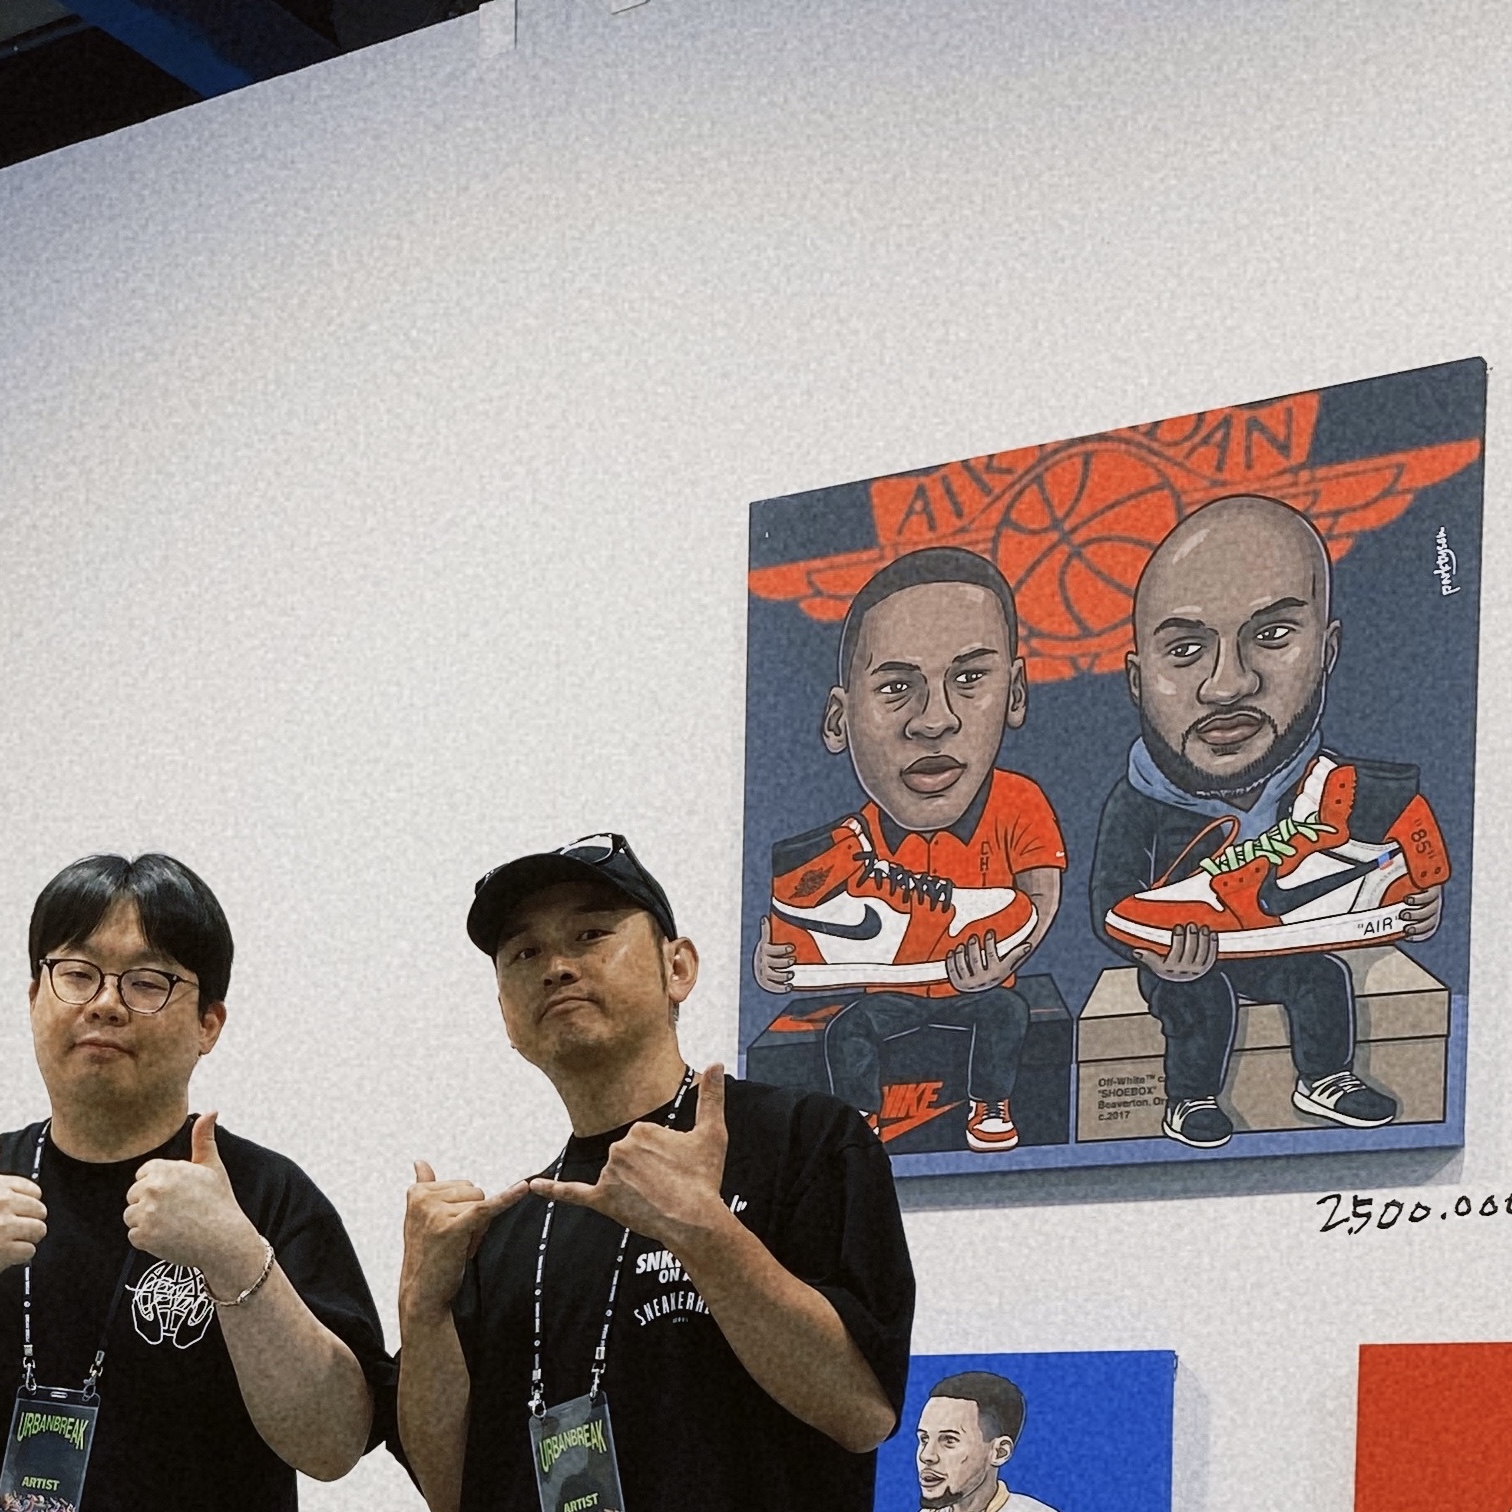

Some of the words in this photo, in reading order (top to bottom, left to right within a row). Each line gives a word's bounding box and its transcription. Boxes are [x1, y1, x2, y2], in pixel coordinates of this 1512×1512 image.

[658, 1267, 681, 1284] ON
[16, 1411, 89, 1451] URBANBREAK
[538, 1419, 607, 1473] URBANBREAK
[21, 1476, 60, 1491] ARTIST
